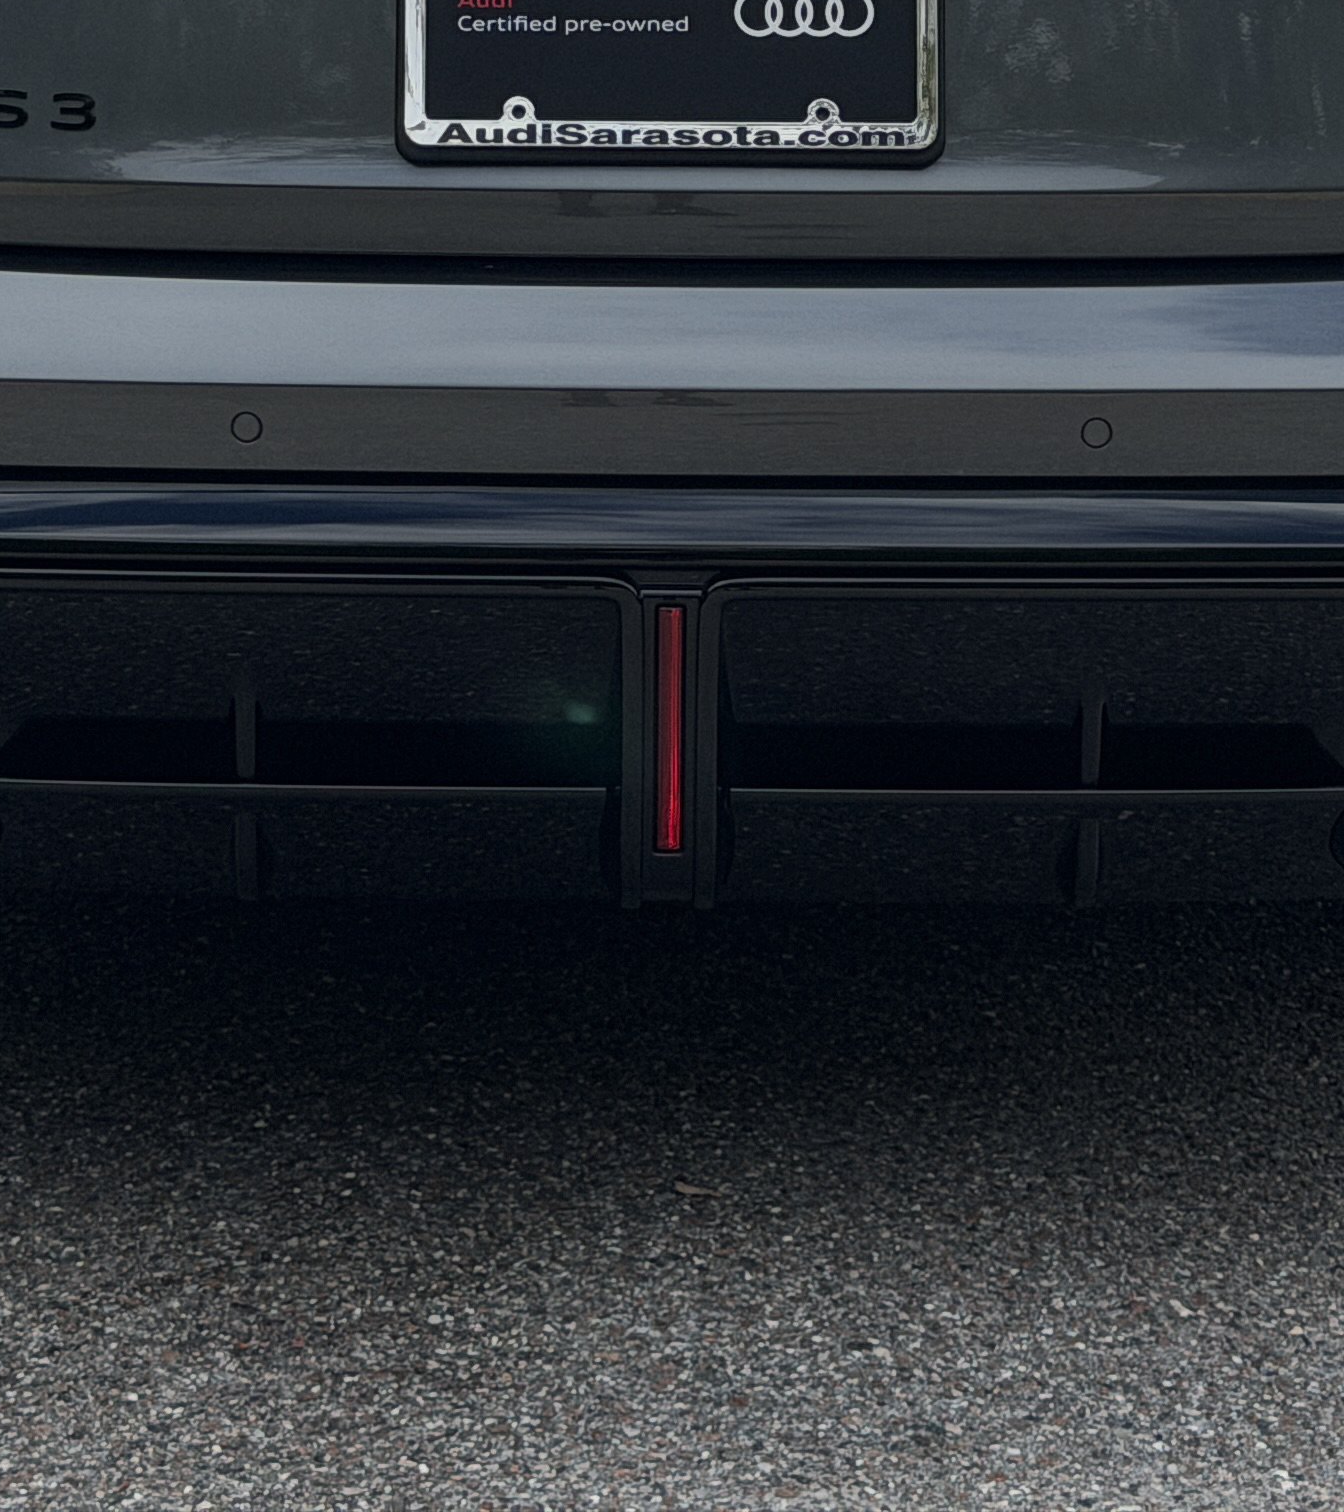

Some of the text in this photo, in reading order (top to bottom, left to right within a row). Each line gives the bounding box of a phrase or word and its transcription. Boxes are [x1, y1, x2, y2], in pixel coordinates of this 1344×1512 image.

[457, 15, 689, 36] Certified pre-owned
[50, 93, 97, 131] 3
[437, 122, 905, 147] AudiSarasota.com
